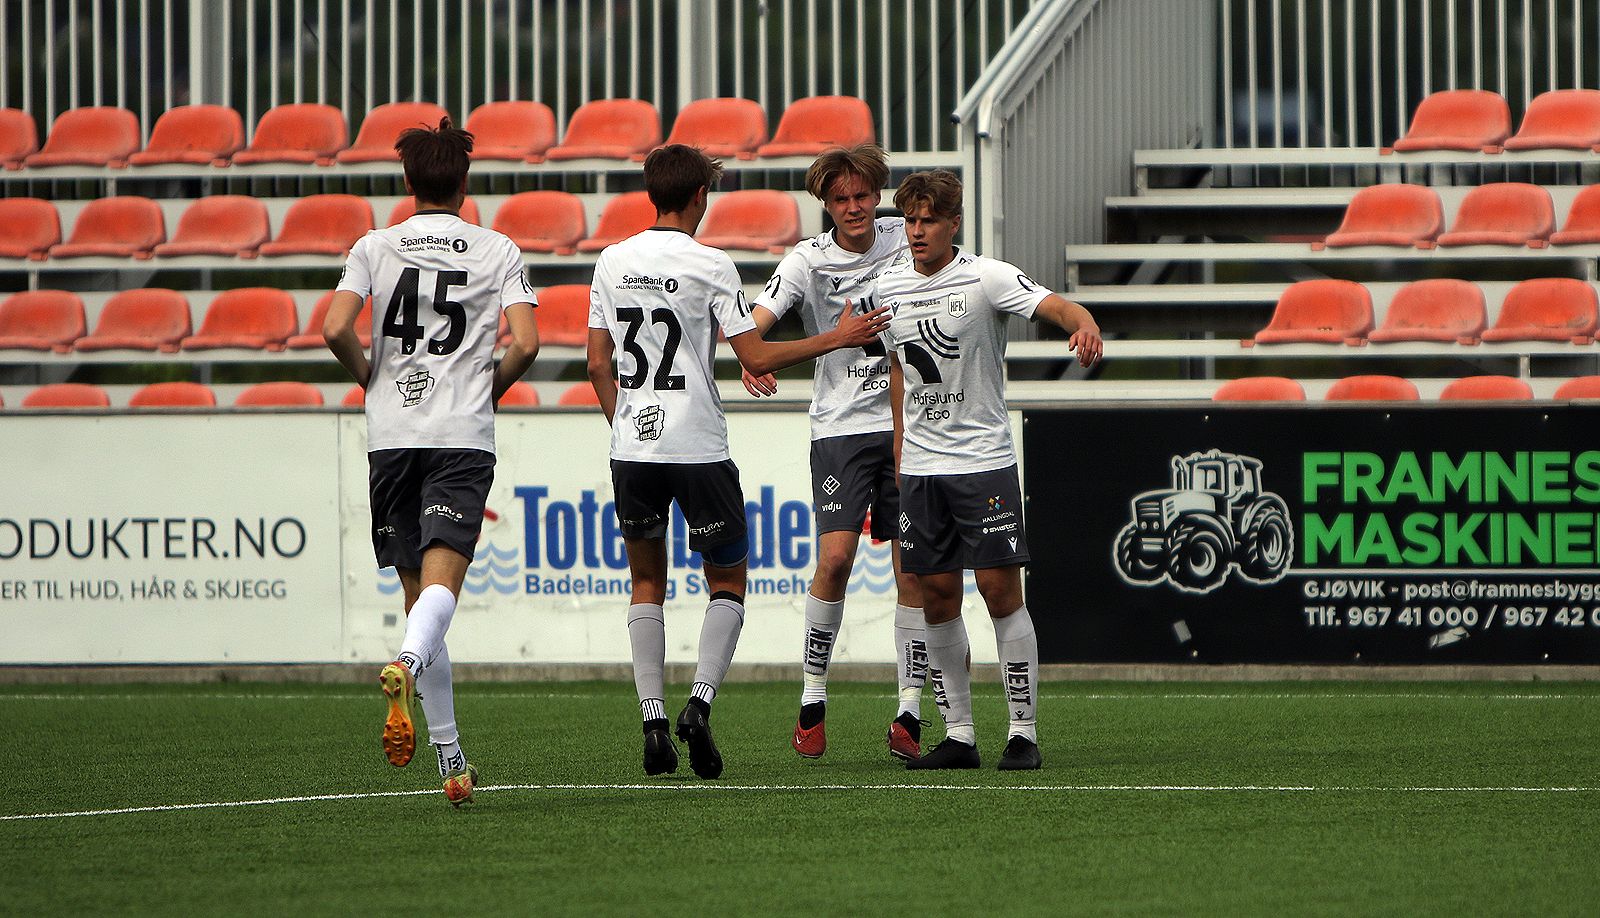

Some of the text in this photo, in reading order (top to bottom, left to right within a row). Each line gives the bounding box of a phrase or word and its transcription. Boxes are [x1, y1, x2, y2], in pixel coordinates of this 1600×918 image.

[400, 235, 451, 247] SpareBank
[622, 275, 664, 286] SpareBank
[382, 267, 468, 356] 45
[950, 300, 965, 313] HFK
[615, 307, 686, 390] 32
[847, 365, 892, 378] Hafslu
[862, 380, 889, 392] Eco
[911, 389, 965, 406] Hafslund
[925, 408, 951, 420] Eco
[1303, 450, 1600, 503] FRAMNES
[982, 511, 1015, 523] HALLINGDAL
[0, 517, 308, 560] ODUKTER.NO
[1304, 511, 1600, 564] MASKINE
[1, 574, 288, 602] ER TIL HUD, HÅR & SKJEGG
[1303, 580, 1385, 599] GJØVIK
[1304, 606, 1342, 626] Tlf.
[1348, 606, 1391, 626] 967
[1398, 607, 1422, 626] 41
[1429, 606, 1479, 626] 000
[1484, 604, 1498, 630] /
[1504, 606, 1548, 626] 967
[1554, 606, 1585, 626] 42
[808, 627, 833, 671] NEXT
[911, 639, 930, 683] NEXT
[1006, 661, 1031, 706] NEXT
